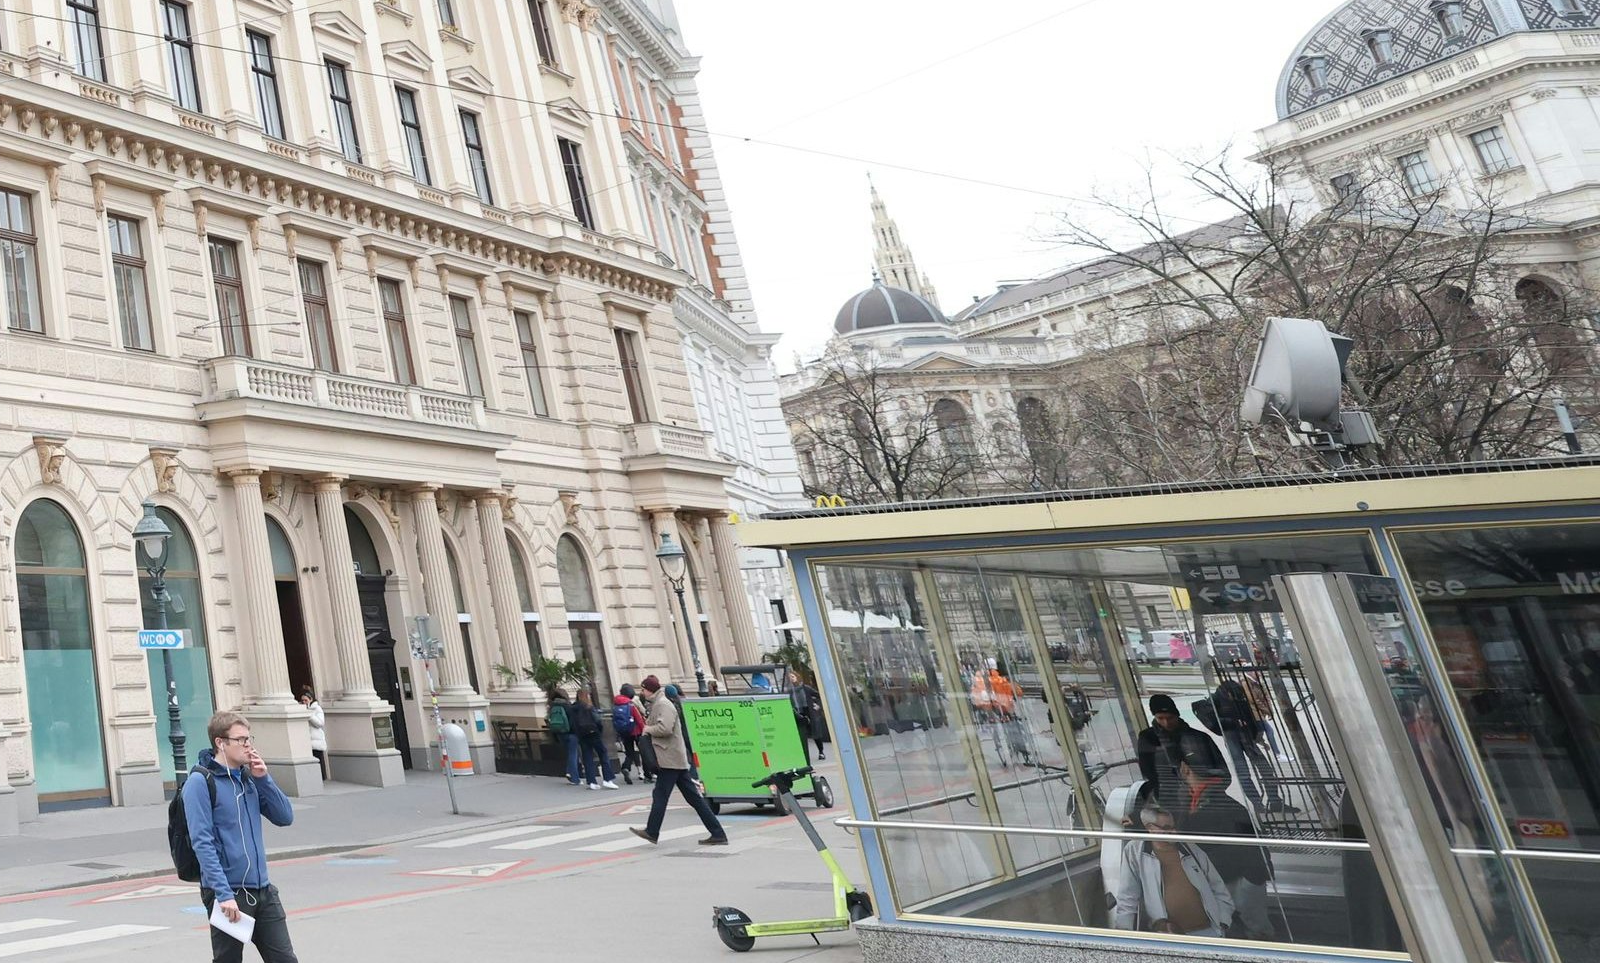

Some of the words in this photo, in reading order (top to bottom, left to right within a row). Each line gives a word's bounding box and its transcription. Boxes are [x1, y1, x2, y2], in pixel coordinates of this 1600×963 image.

[140, 634, 156, 645] WC
[691, 707, 734, 722] jumug
[1519, 822, 1567, 835] oe24
